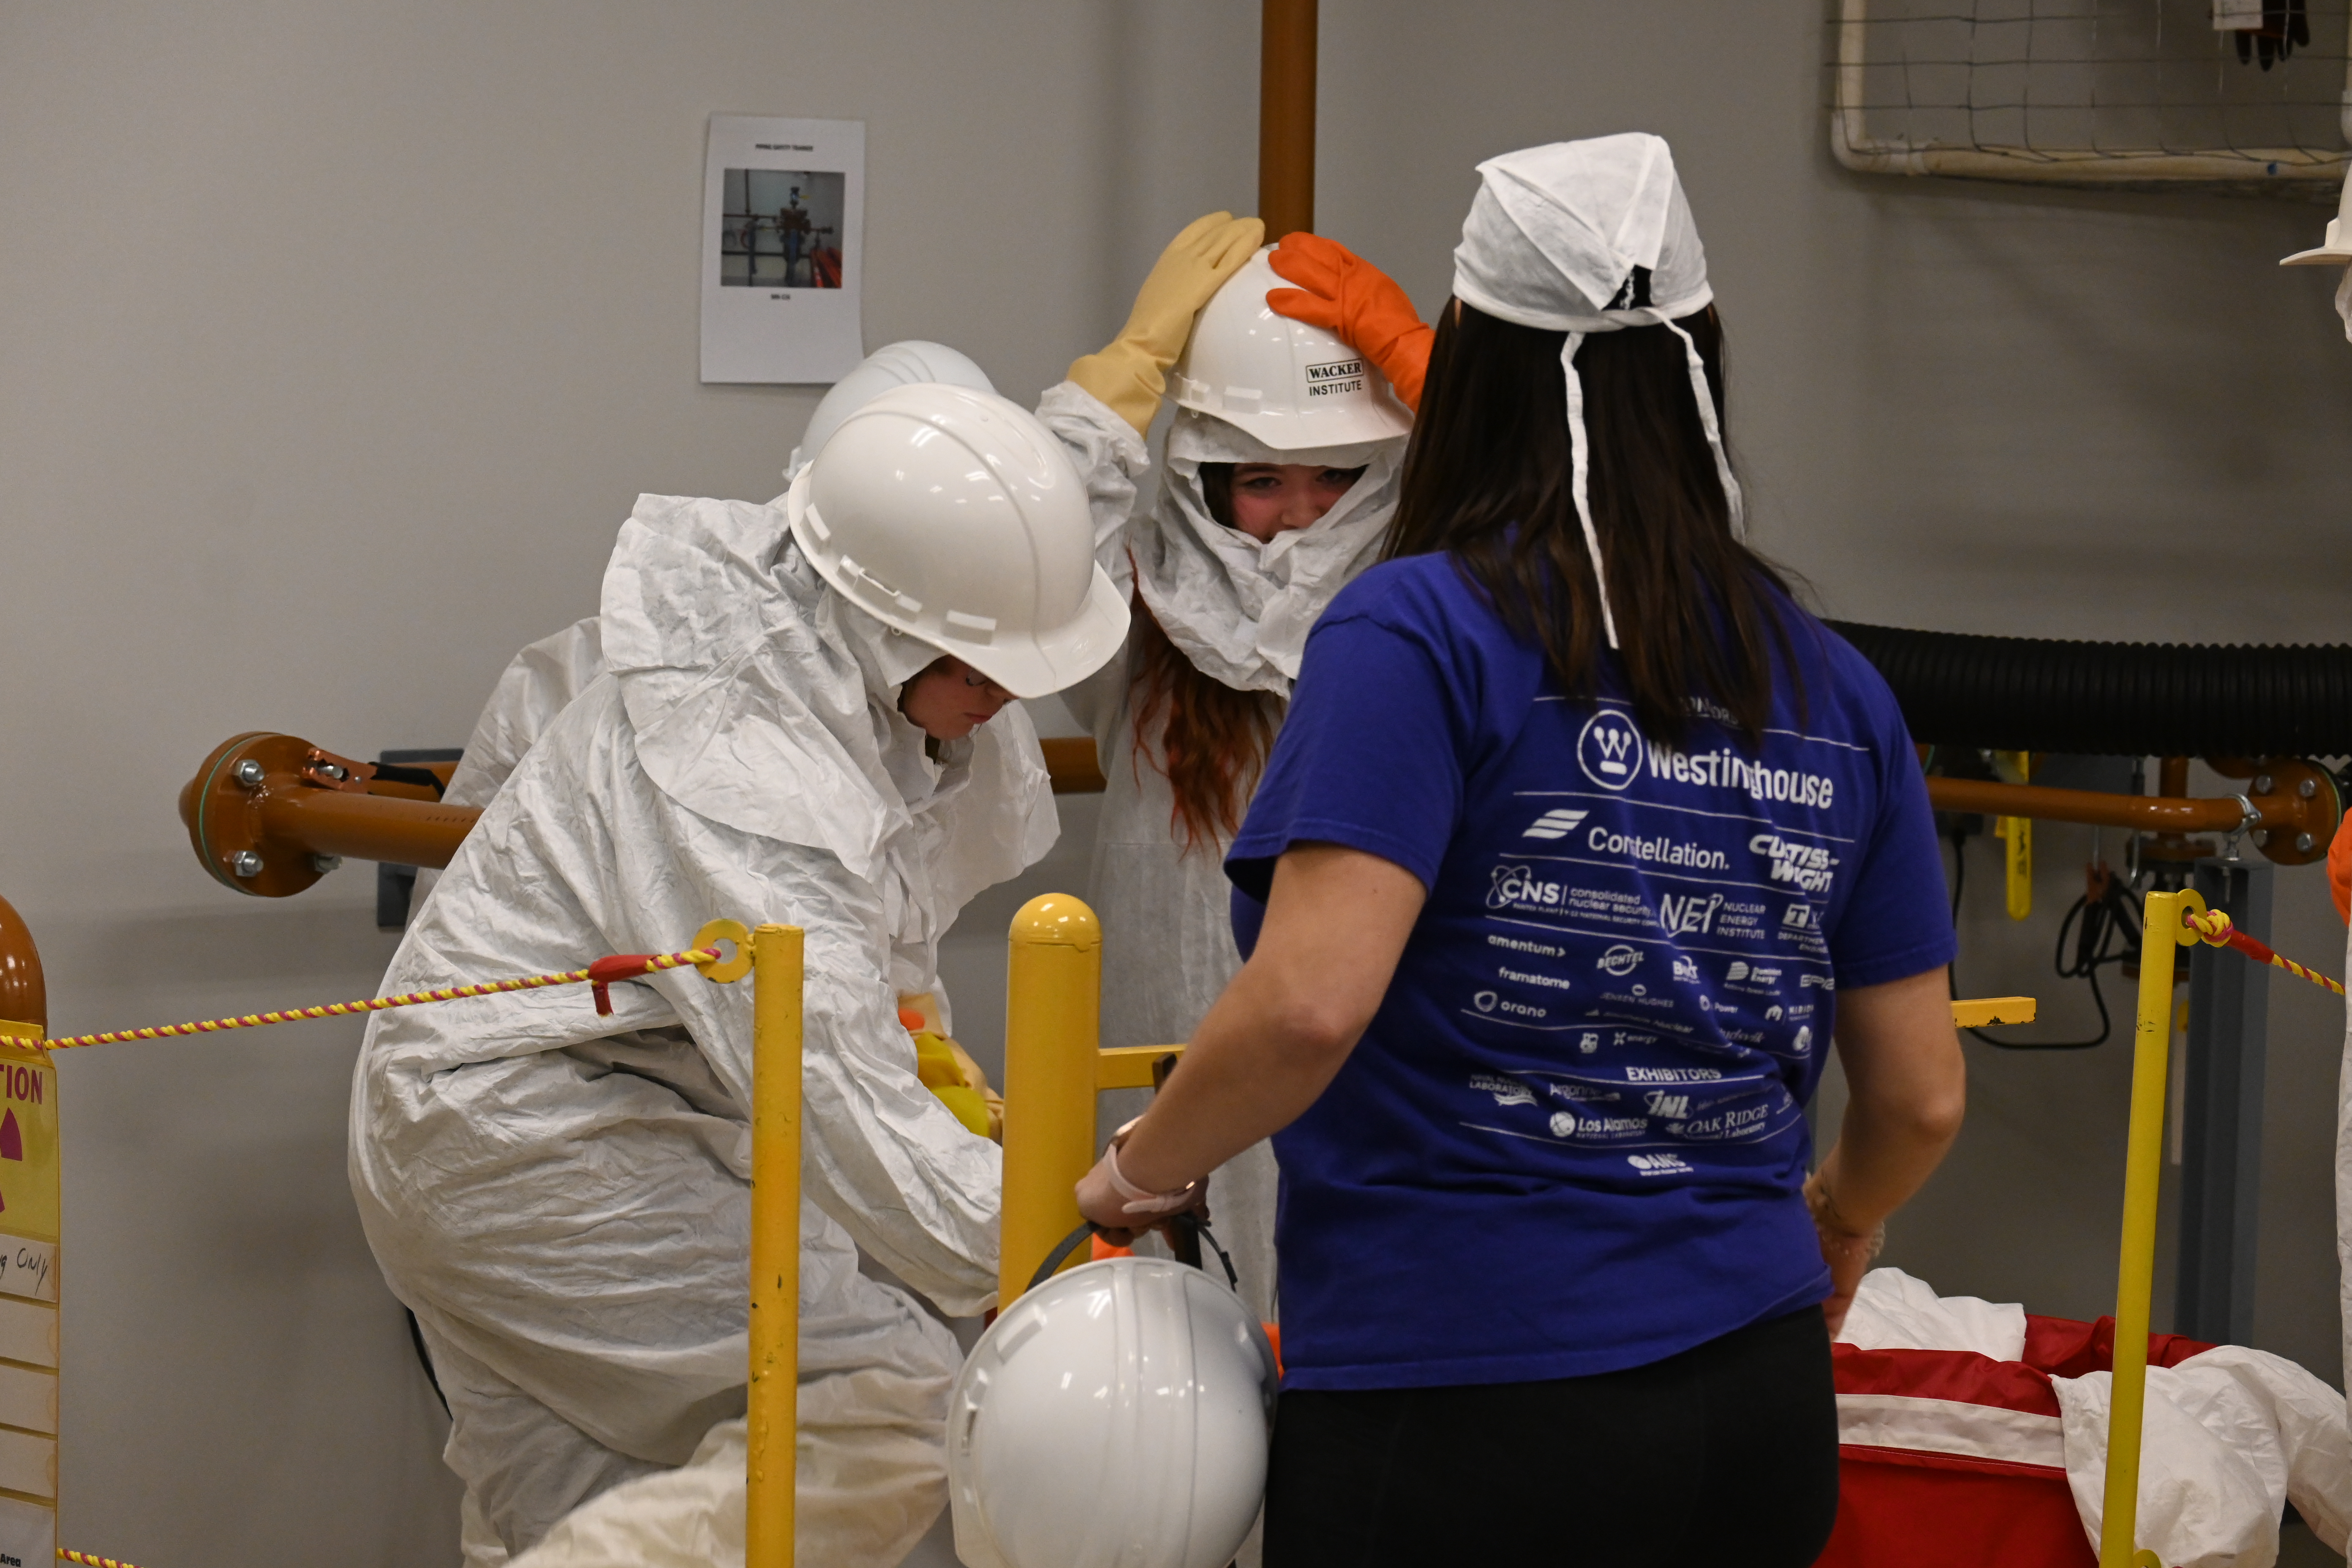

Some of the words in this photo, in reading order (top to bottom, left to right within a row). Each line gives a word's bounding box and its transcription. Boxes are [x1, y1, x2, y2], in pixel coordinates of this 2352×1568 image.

[1309, 362, 1361, 378] WACKER
[1309, 380, 1361, 396] INSTITUTE
[1588, 826, 1730, 870] Contellation.
[1749, 834, 1840, 870] CUTISS-
[1770, 858, 1834, 893] WIGHT
[1502, 879, 1560, 904] CNS
[1571, 888, 1641, 905] consolidated
[1569, 898, 1610, 910] nuclear
[1723, 902, 1766, 914] NUCLEAR
[1720, 914, 1759, 926] ENERGY
[1716, 926, 1765, 939] INSTITUTE
[1488, 935, 1556, 957] amentum
[1597, 951, 1644, 969] BECHTEL
[1499, 966, 1570, 989] framatome
[1500, 1001, 1546, 1018] orano
[1625, 1066, 1722, 1081] EXHIBITORS
[1578, 1117, 1601, 1132] Los
[1687, 1116, 1722, 1134] OAK
[1725, 1104, 1768, 1128] RIDGE
[0, 1553, 21, 1568] Area
